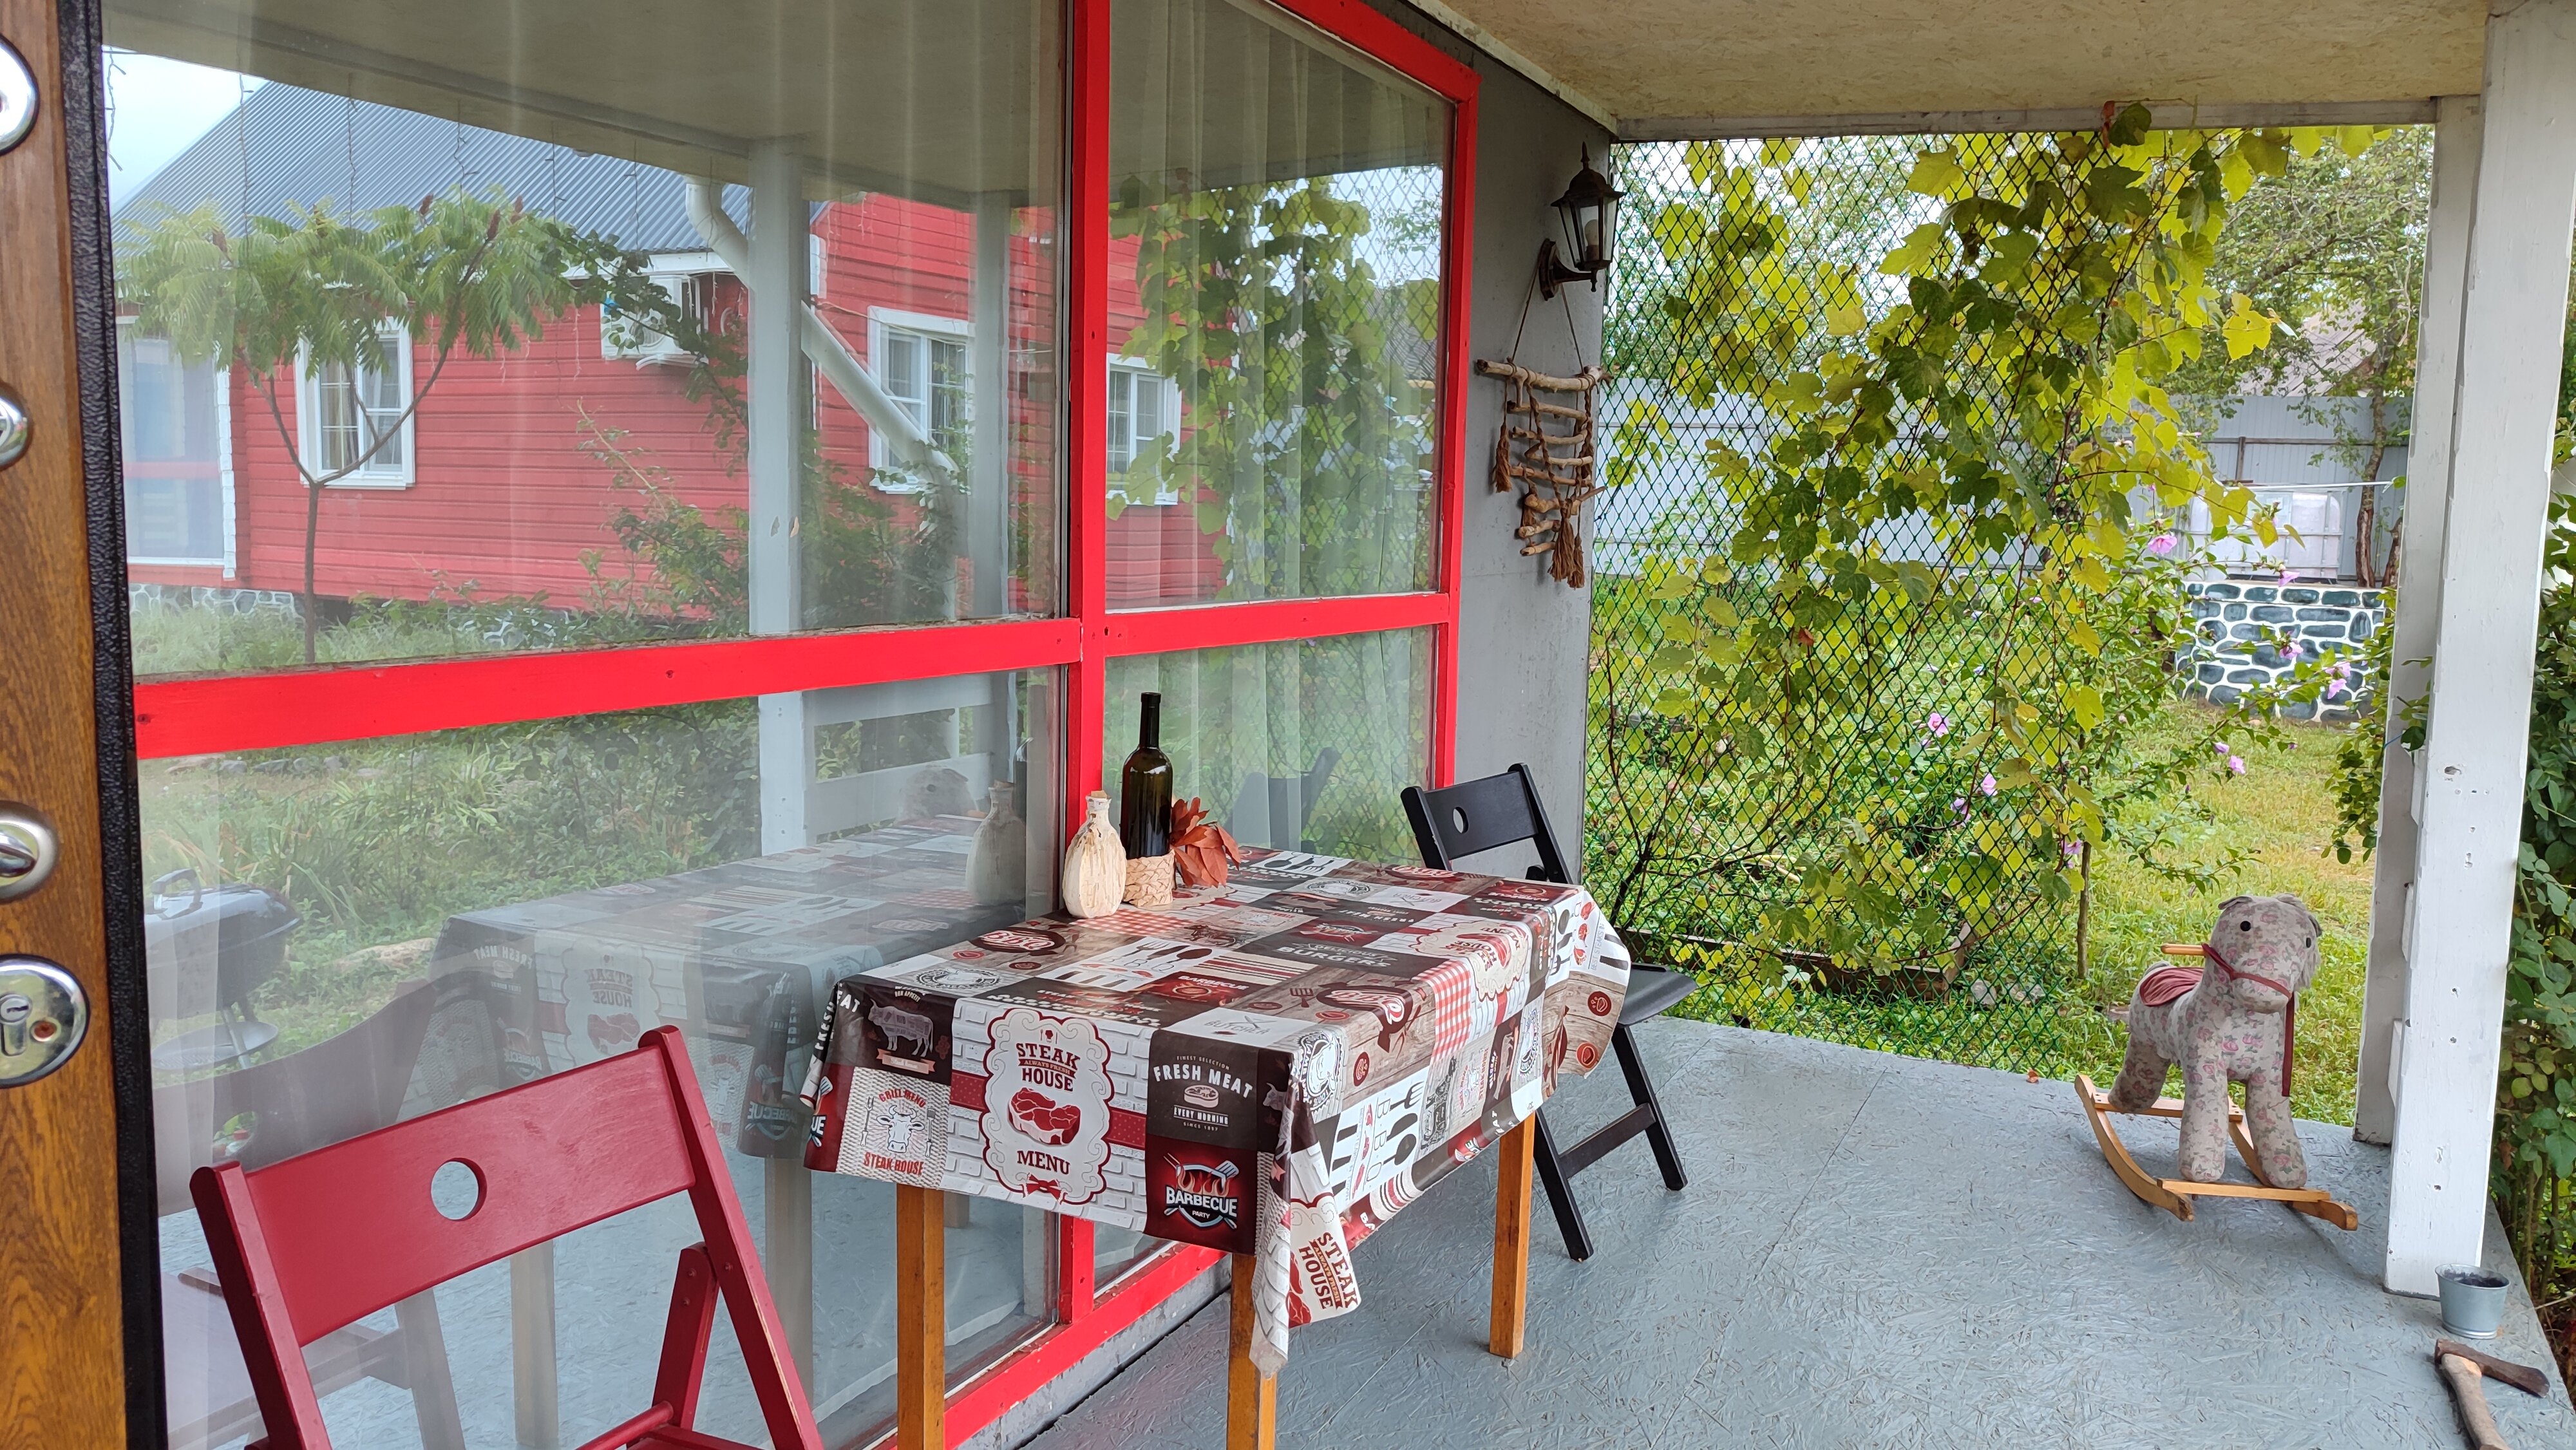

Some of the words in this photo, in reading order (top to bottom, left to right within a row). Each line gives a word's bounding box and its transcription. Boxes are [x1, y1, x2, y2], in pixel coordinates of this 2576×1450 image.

[978, 930, 1056, 952] BBQ
[1314, 945, 1376, 958] DELICIOUS
[1277, 946, 1392, 967] BURGERS
[1178, 975, 1250, 990] BARBECUE
[1204, 1019, 1272, 1035] BUTCHER
[1016, 1042, 1081, 1071] STEAK
[1198, 1057, 1231, 1071] SELECTION
[1023, 1060, 1050, 1069] ALWAYS
[1049, 1062, 1071, 1077] FRESH
[1021, 1067, 1074, 1093] HOUSE
[1153, 1064, 1202, 1082] FRESH
[1208, 1069, 1254, 1099] MEAT
[878, 1088, 903, 1102] GRILL
[904, 1089, 925, 1108] MENU
[1173, 1106, 1195, 1119] EVERY
[1197, 1111, 1229, 1126] MORNING
[864, 1151, 893, 1171] STEAK
[893, 1158, 925, 1176] HOUSE
[1016, 1149, 1071, 1176] MENU
[1166, 1186, 1238, 1218] BARBECUE
[1191, 1210, 1211, 1219] PARTY
[1298, 1246, 1334, 1310] HOUSE
[1317, 1232, 1358, 1308] STEAK
